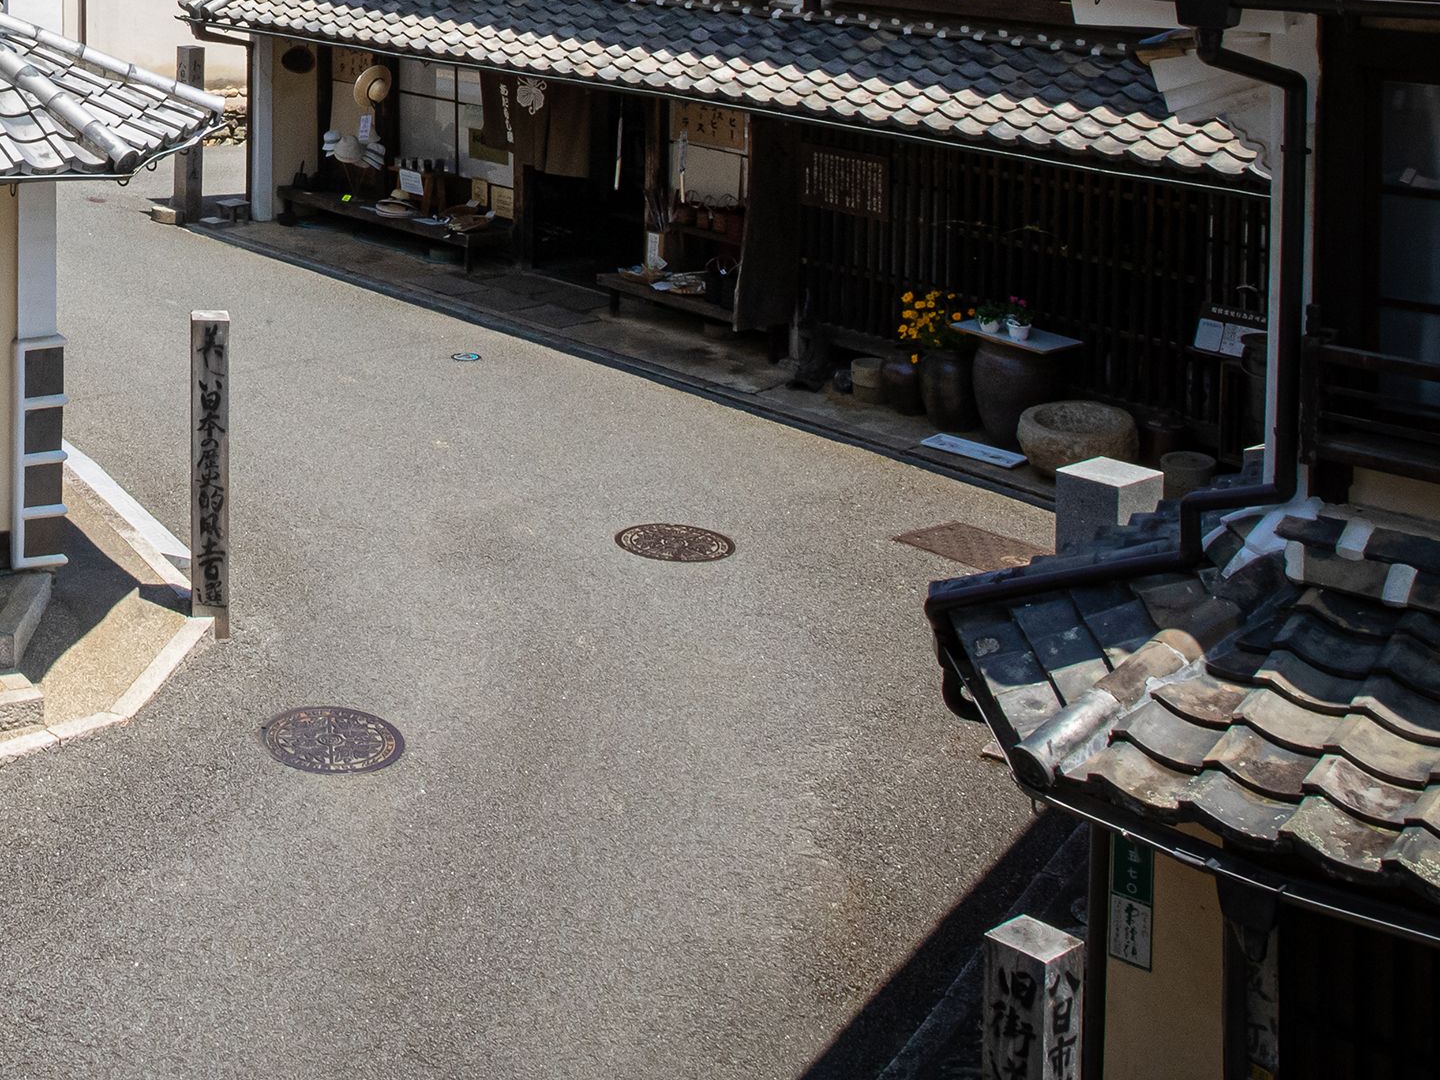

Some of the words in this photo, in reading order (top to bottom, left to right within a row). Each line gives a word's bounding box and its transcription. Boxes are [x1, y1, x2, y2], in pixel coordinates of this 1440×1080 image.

[197, 323, 228, 609] 美しい日本の歴史的風土百選
[1047, 970, 1081, 1080] 八日市
